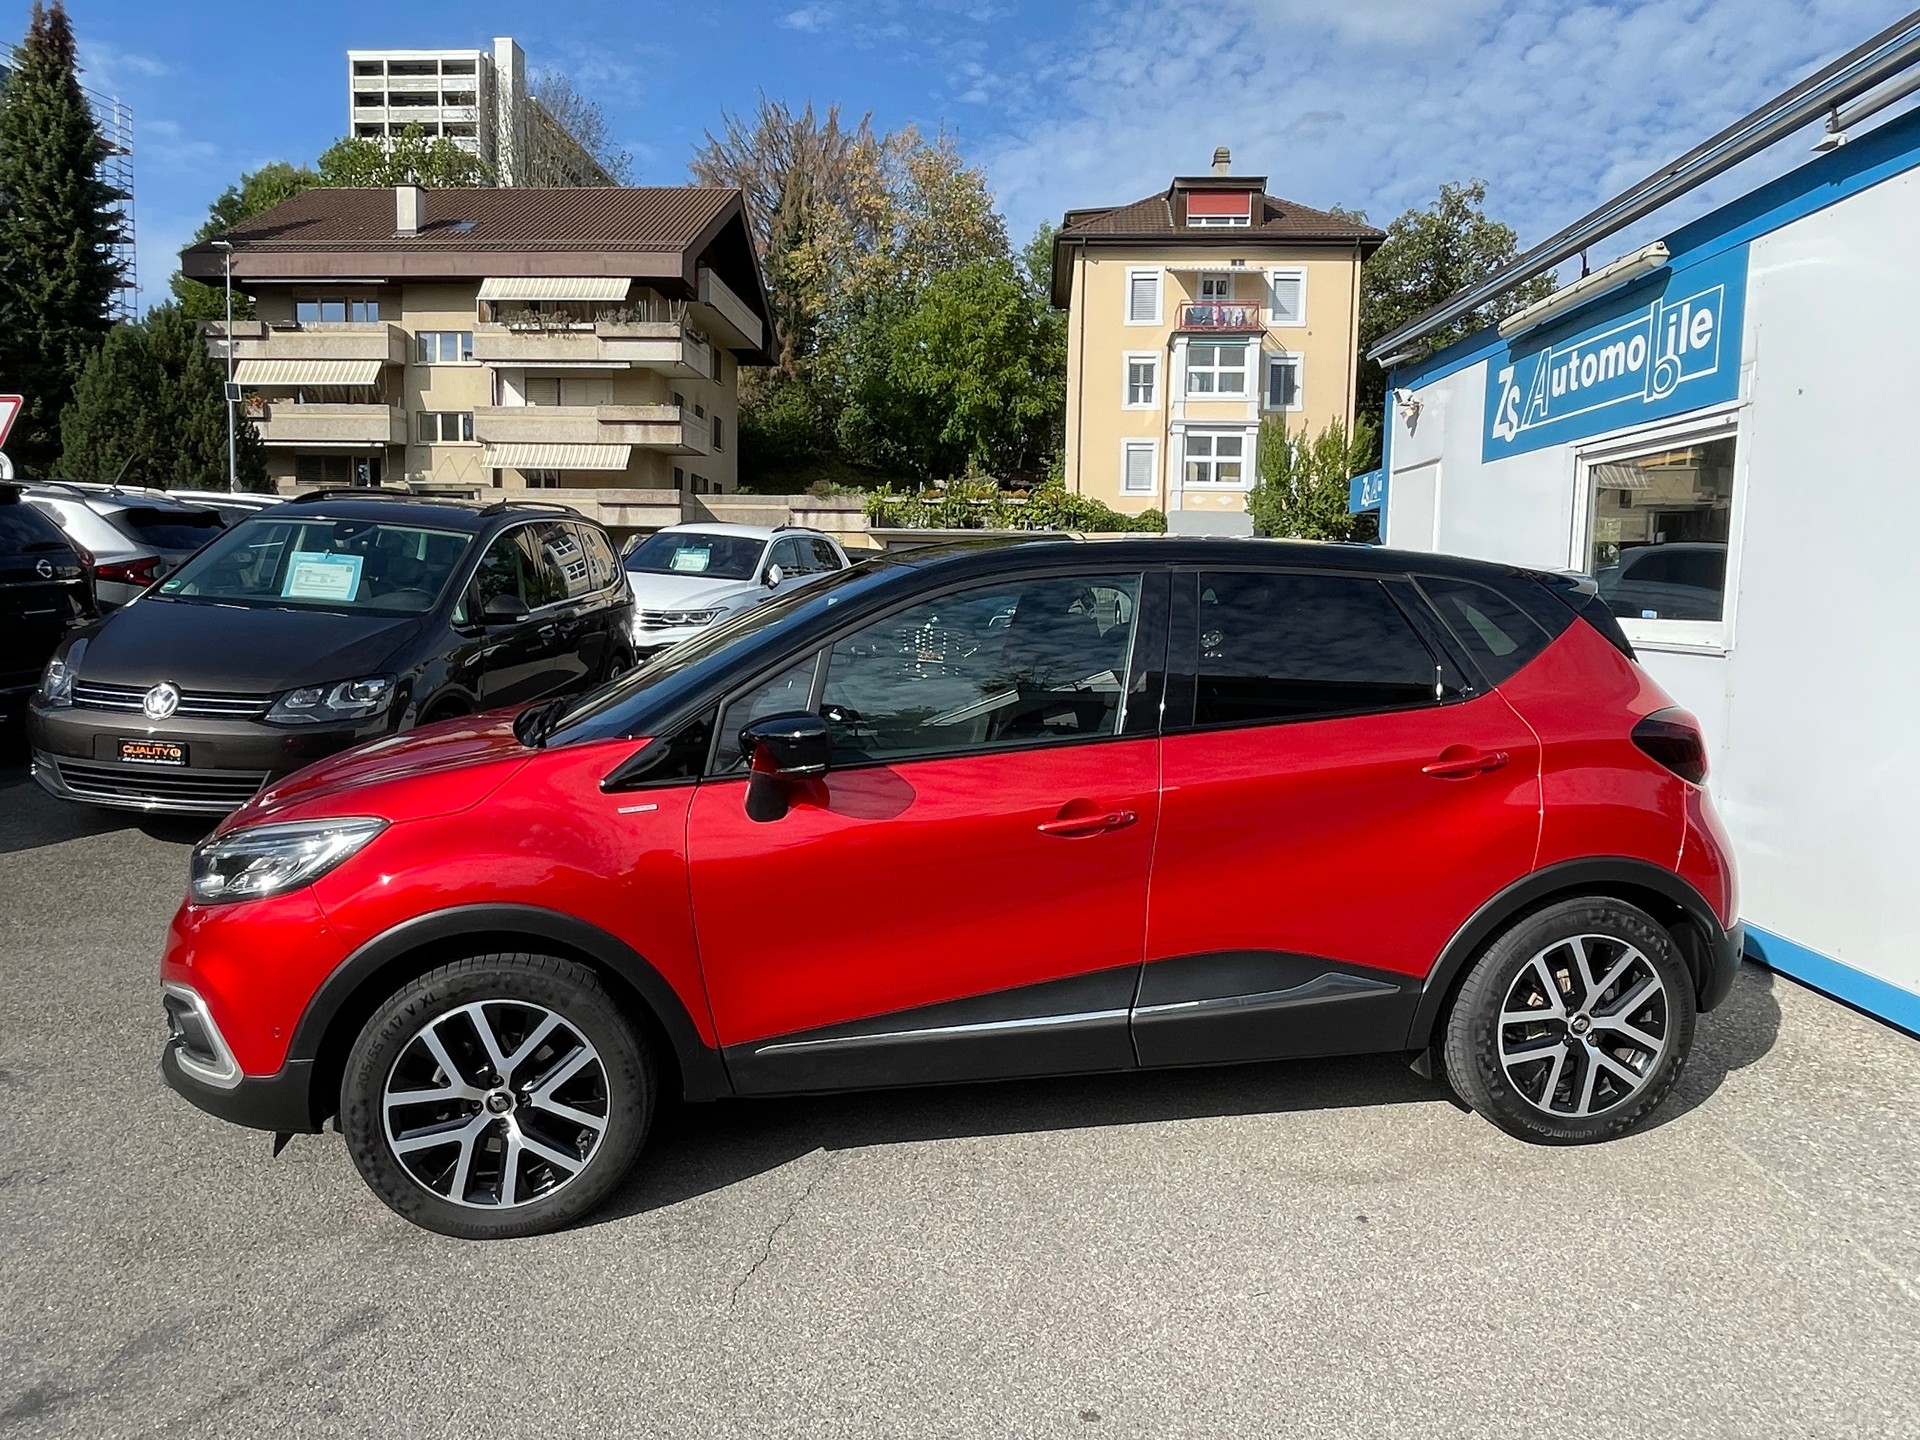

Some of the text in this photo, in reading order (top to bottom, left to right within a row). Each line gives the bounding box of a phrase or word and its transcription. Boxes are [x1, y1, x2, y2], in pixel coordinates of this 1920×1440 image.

[1492, 297, 1713, 442] Zs Automobile
[404, 1003, 416, 1016] V
[419, 992, 441, 1009] XL
